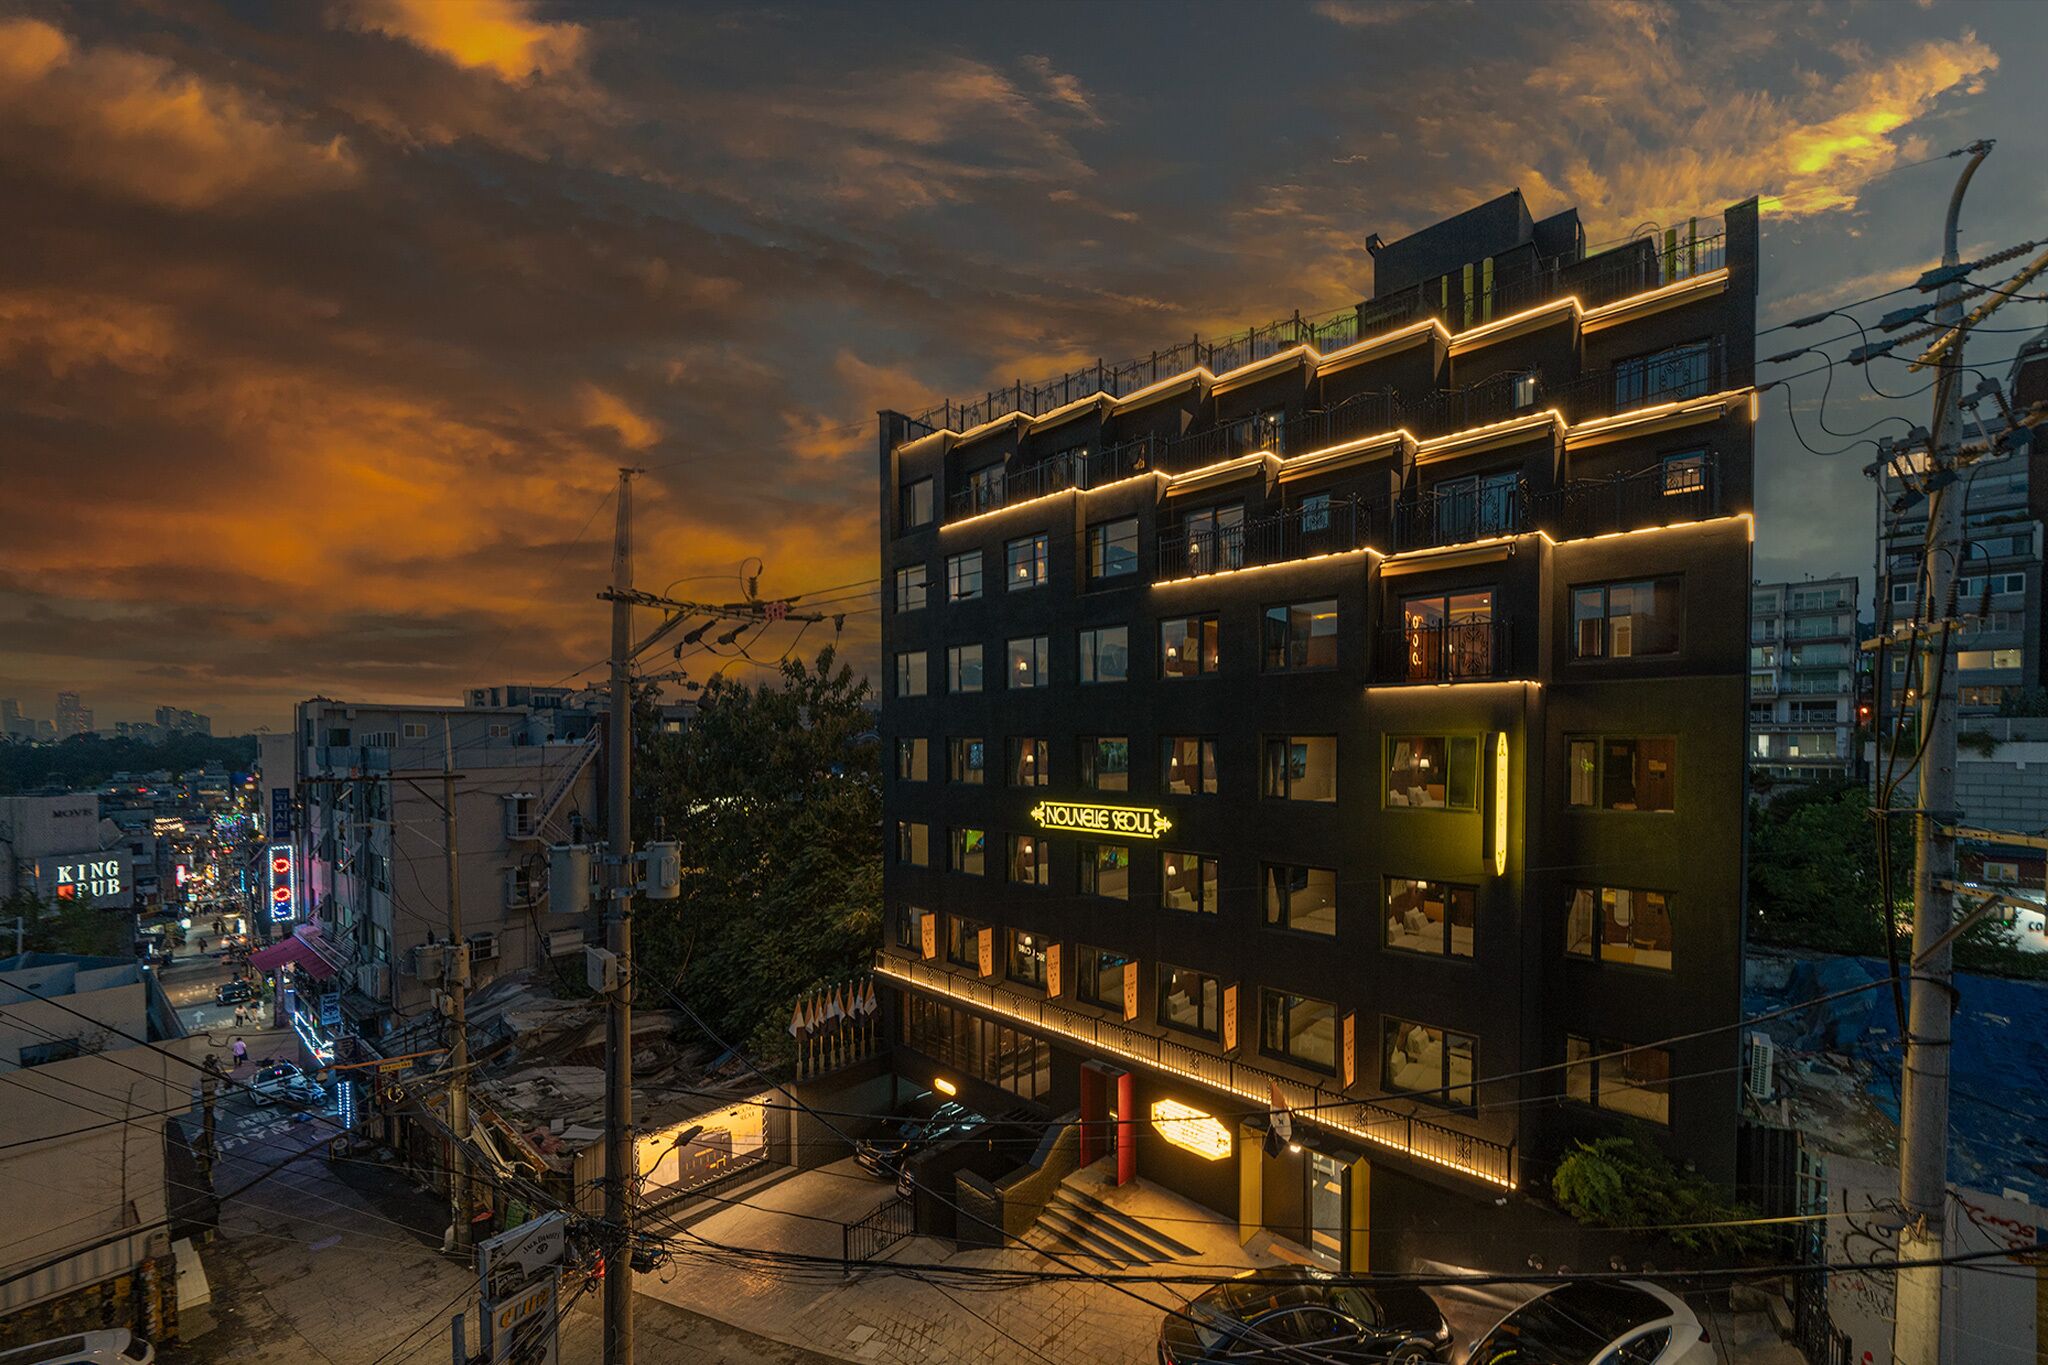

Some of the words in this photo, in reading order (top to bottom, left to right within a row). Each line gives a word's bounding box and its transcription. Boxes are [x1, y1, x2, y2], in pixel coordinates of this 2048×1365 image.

[1046, 806, 1109, 829] NOUVELLE
[1112, 811, 1152, 833] SEOUL
[57, 860, 120, 883] KING
[75, 878, 121, 899] PUB
